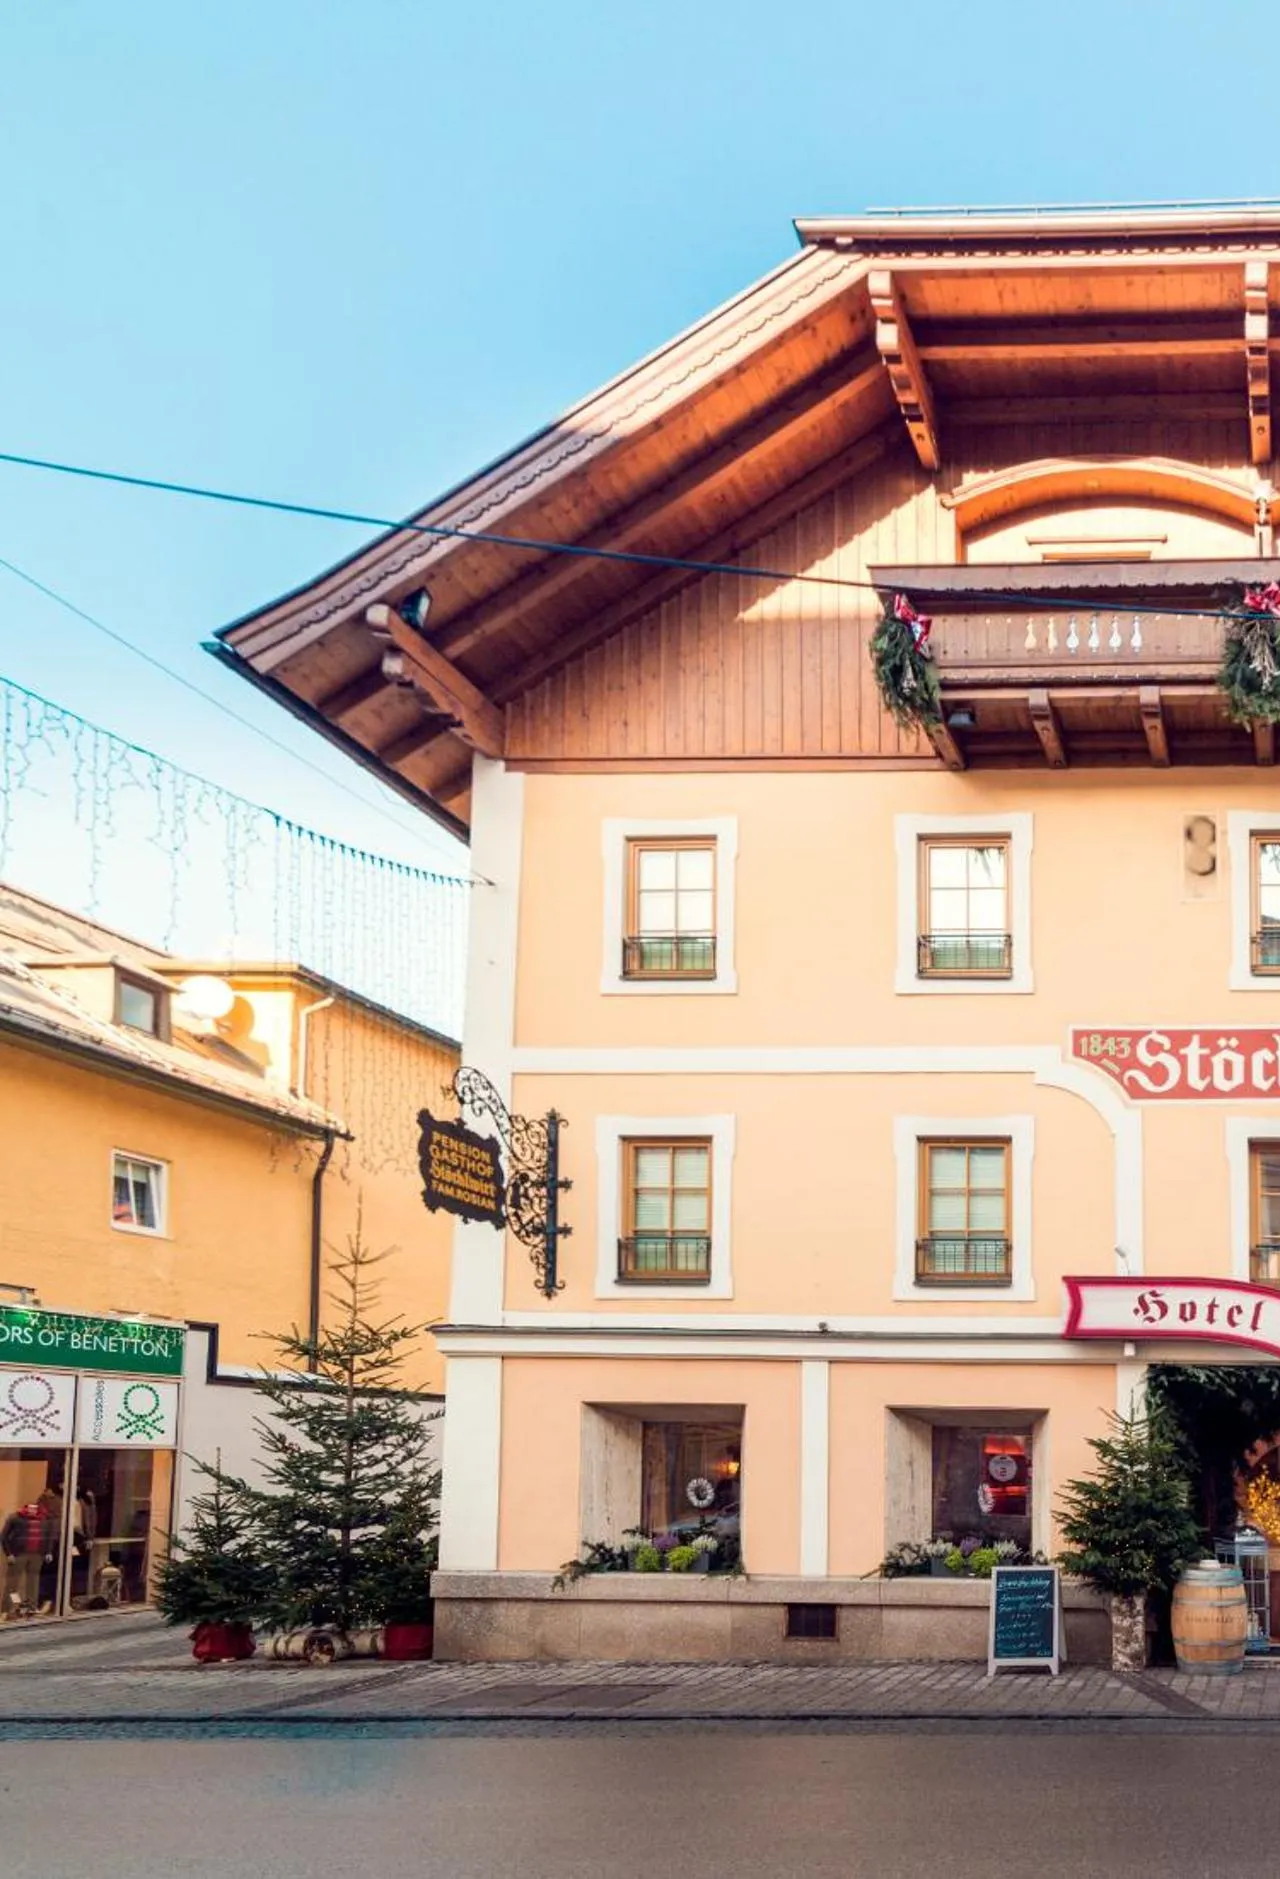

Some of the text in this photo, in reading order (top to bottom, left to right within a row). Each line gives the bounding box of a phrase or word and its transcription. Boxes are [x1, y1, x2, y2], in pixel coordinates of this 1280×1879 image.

[1079, 1035, 1131, 1059] 1843
[430, 1146, 494, 1177] GASTHOF
[432, 1132, 490, 1163] PENSION
[1133, 1289, 1264, 1332] Hotel
[38, 1330, 65, 1347] OF
